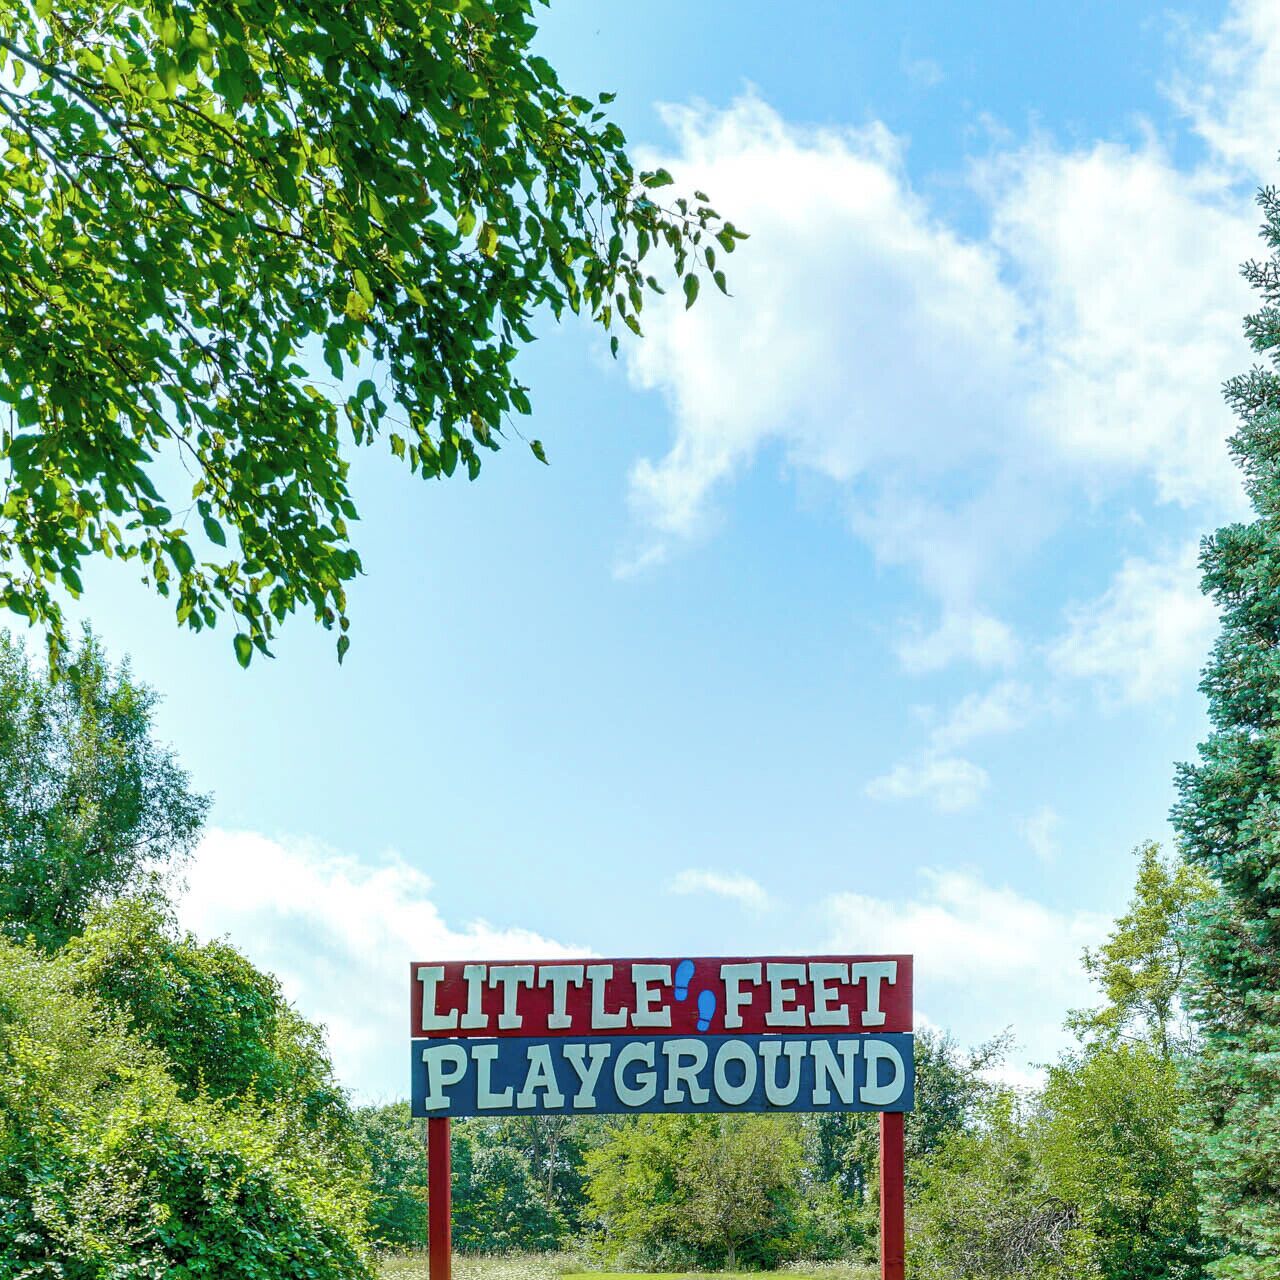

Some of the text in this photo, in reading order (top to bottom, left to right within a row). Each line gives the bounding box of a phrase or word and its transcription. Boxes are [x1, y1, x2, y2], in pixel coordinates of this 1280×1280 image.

[416, 960, 898, 1032] LITTLE FEET
[422, 1038, 906, 1111] PLAYGROUND
